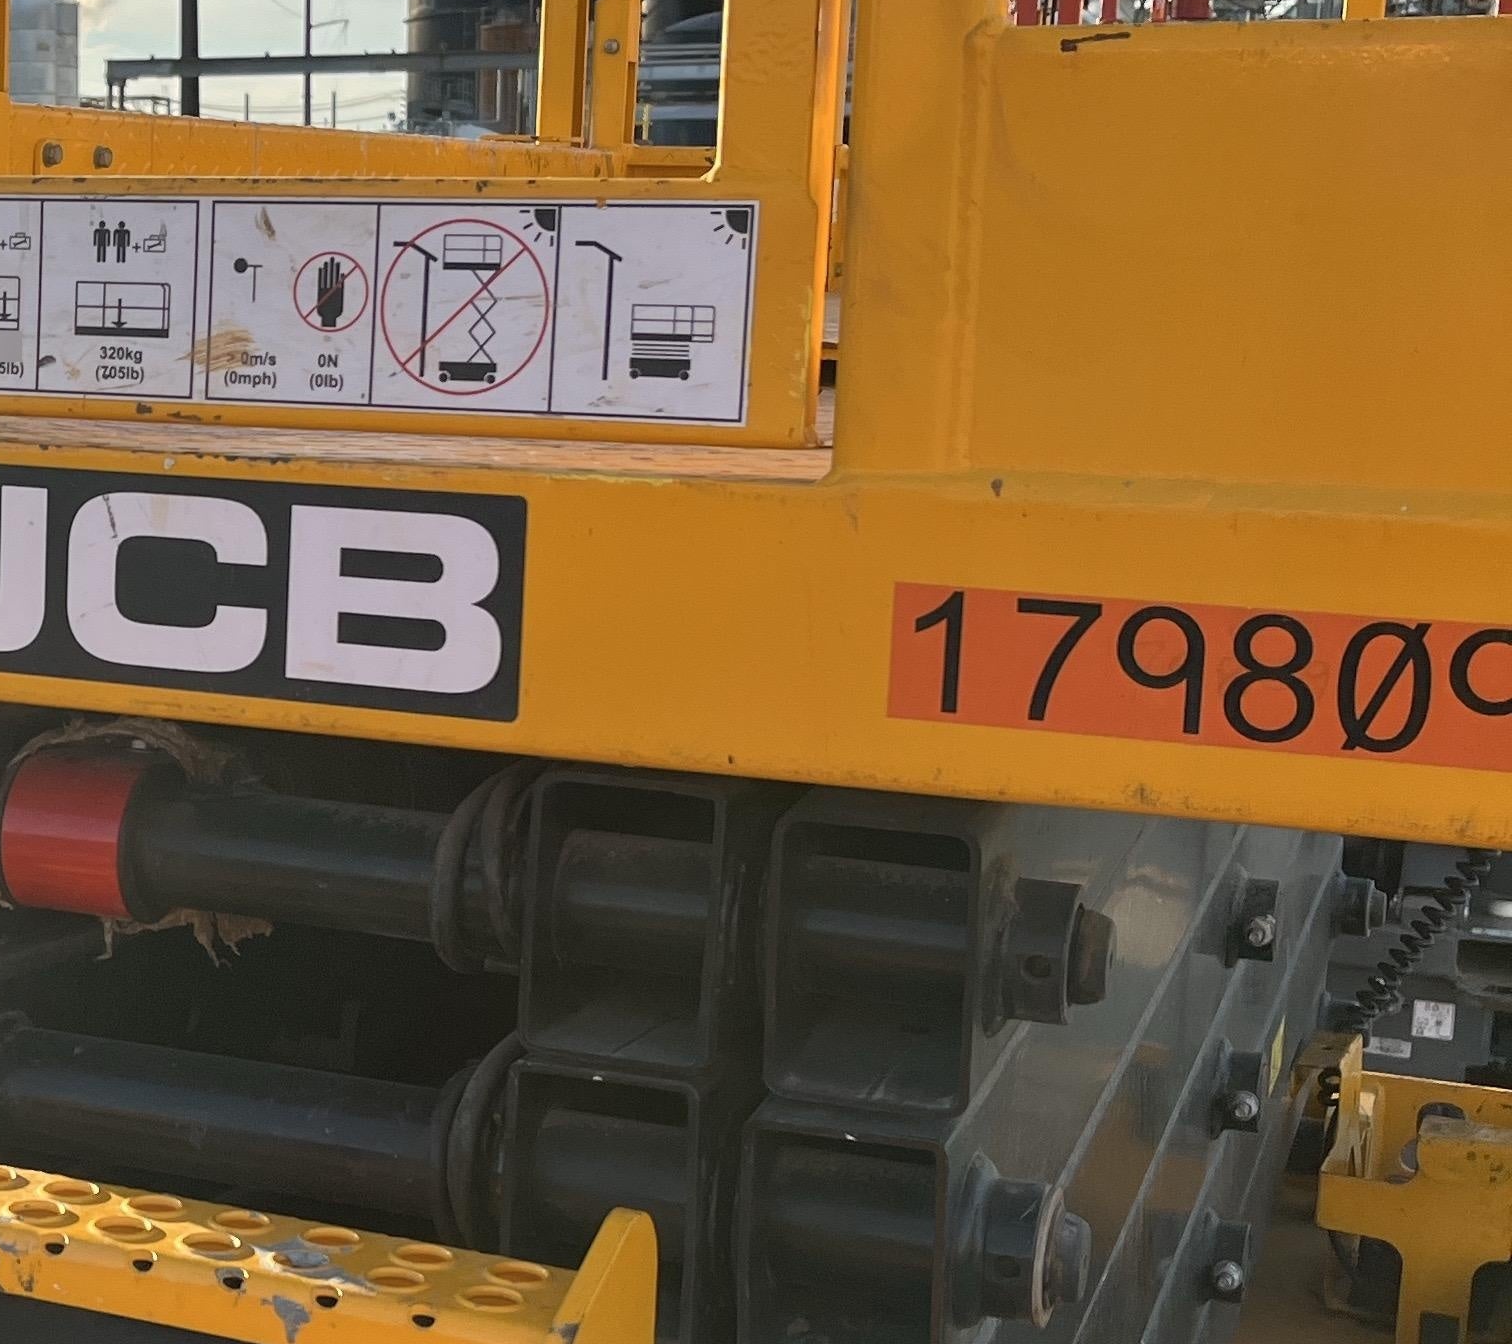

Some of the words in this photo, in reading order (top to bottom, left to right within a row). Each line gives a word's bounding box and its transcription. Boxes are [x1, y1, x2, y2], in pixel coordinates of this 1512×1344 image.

[99, 346, 143, 364] 320kg
[317, 353, 339, 368] 0N
[224, 370, 277, 389] (0mph)
[309, 372, 344, 392] (0lb)
